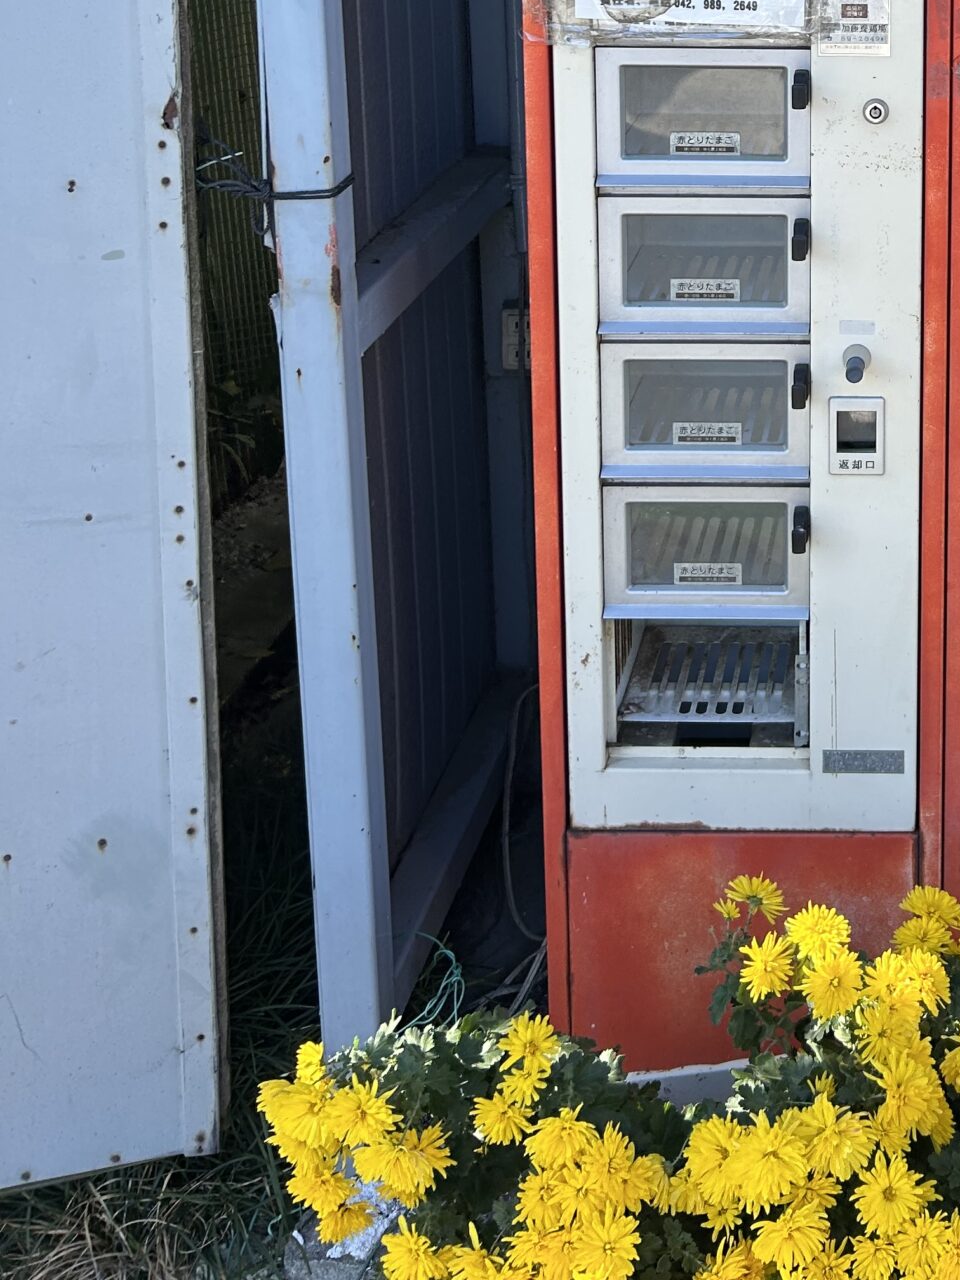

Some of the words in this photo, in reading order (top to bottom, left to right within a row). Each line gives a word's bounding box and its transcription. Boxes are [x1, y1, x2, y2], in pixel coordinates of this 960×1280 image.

[677, 136, 733, 145] 赤どりたまご
[677, 282, 733, 292] 赤どりたまご
[838, 459, 875, 470] 返却口
